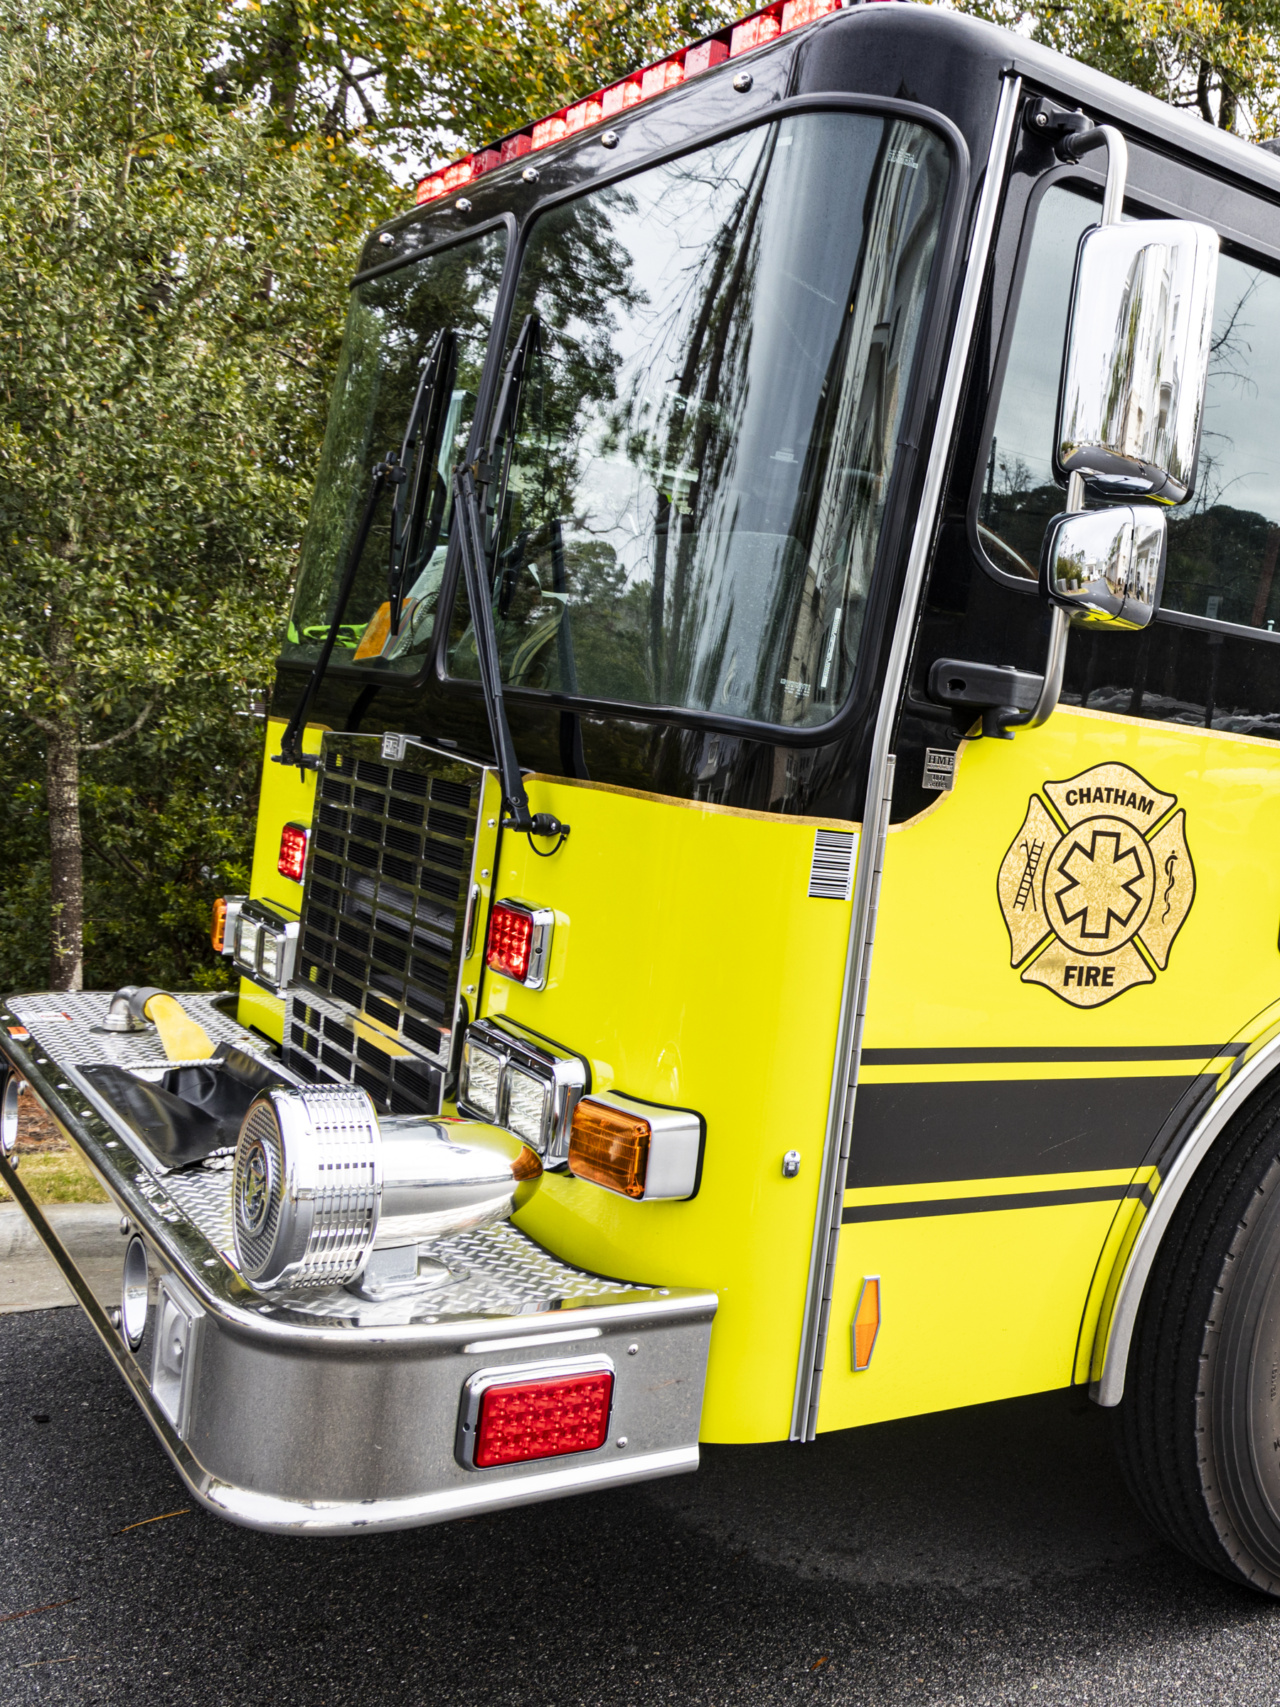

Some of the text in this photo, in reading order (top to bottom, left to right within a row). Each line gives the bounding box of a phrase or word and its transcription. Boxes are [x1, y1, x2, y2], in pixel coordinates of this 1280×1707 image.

[928, 755, 954, 765] HME
[1065, 785, 1155, 816] CHATHAM
[1063, 964, 1115, 989] FIRE
